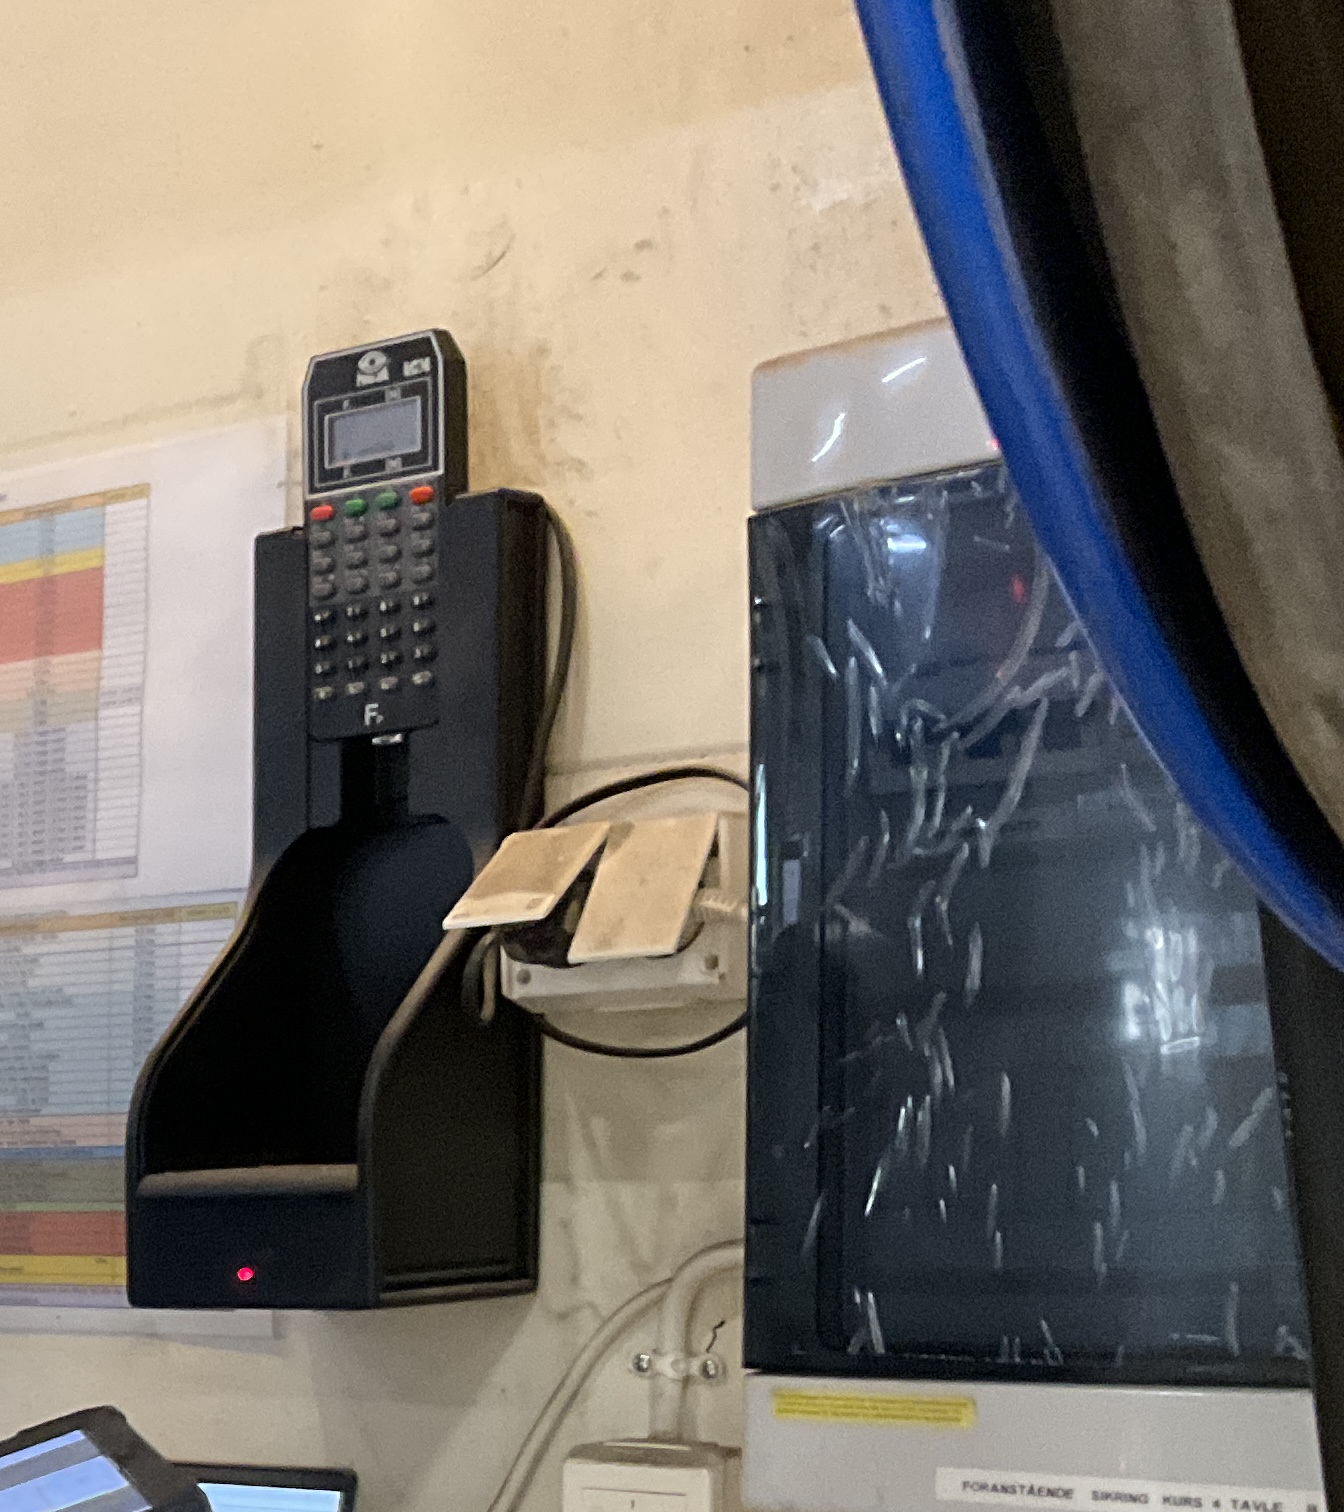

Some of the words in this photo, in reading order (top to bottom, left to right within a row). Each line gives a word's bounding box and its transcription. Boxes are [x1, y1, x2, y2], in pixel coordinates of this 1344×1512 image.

[962, 1480, 1074, 1500] FORANSTÅENDE
[1091, 1490, 1149, 1505] SIKRING
[1162, 1495, 1203, 1509] KURS
